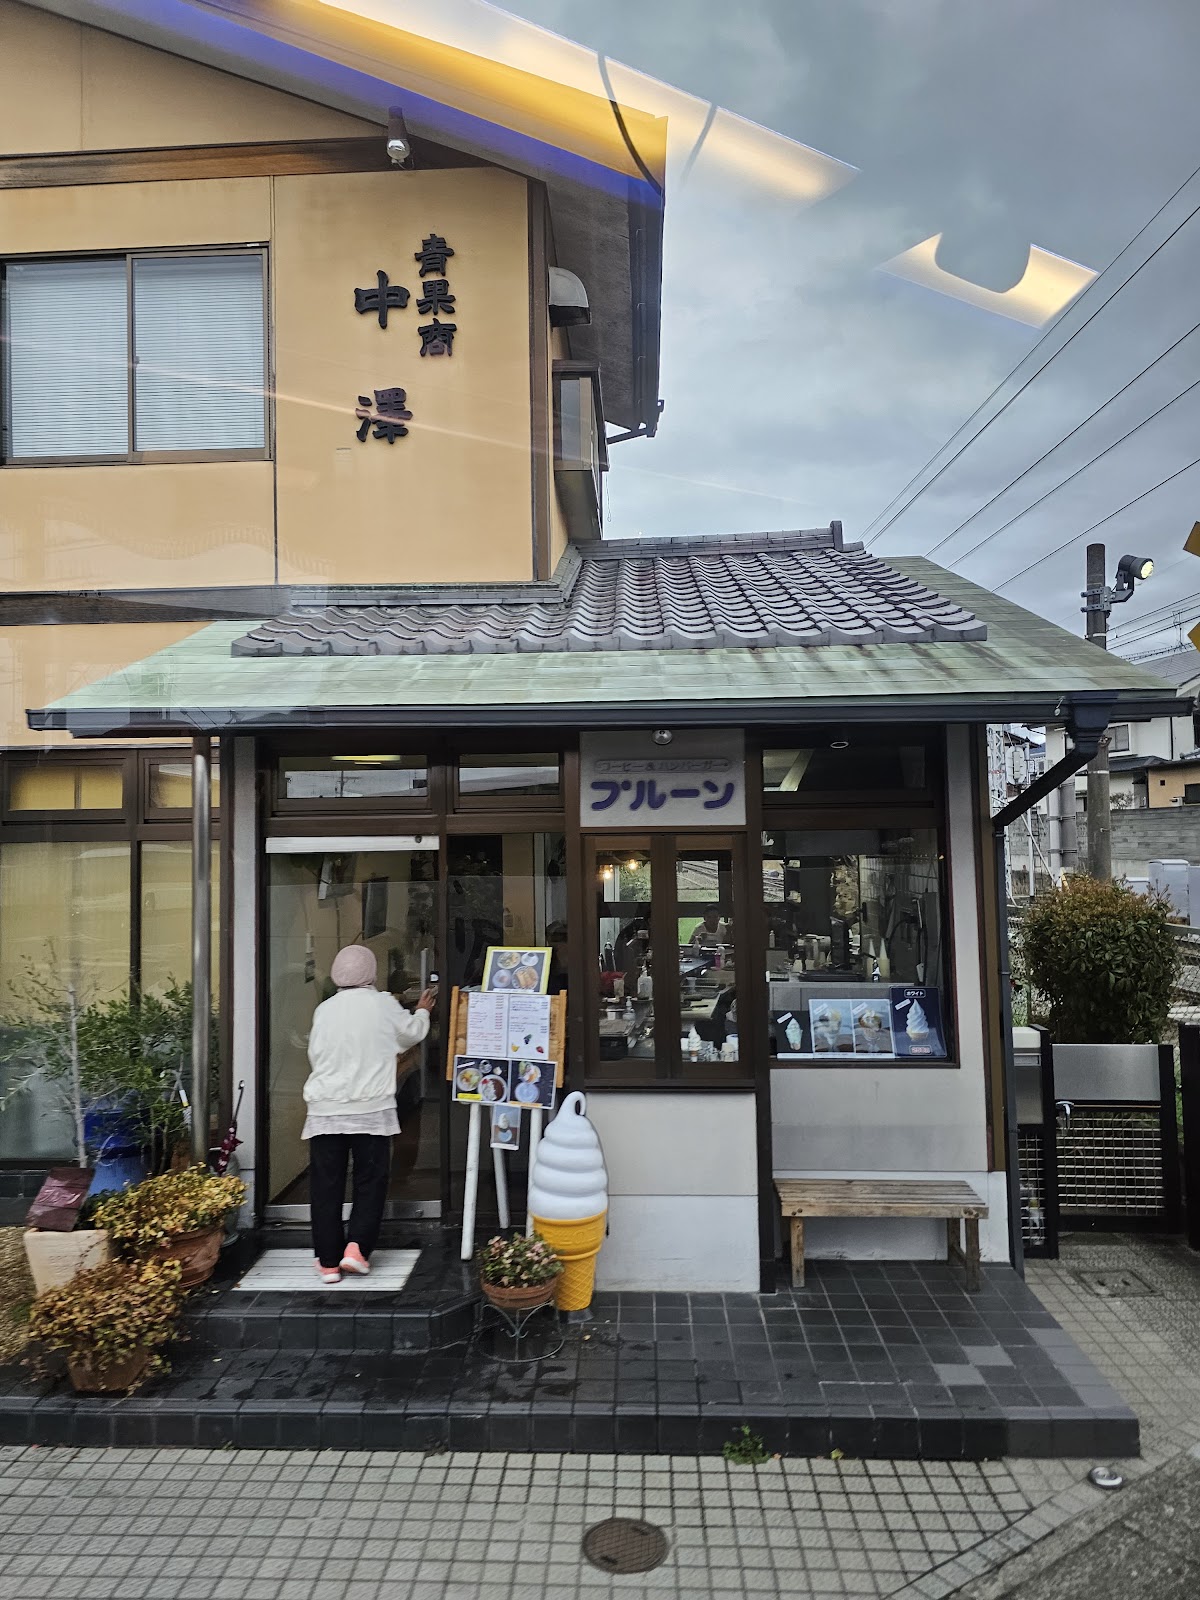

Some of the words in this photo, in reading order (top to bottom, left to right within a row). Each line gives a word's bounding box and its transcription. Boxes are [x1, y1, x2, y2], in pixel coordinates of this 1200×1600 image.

[354, 269, 413, 444] 中澤
[414, 233, 457, 357] 青果商
[591, 779, 735, 811] プルーン
